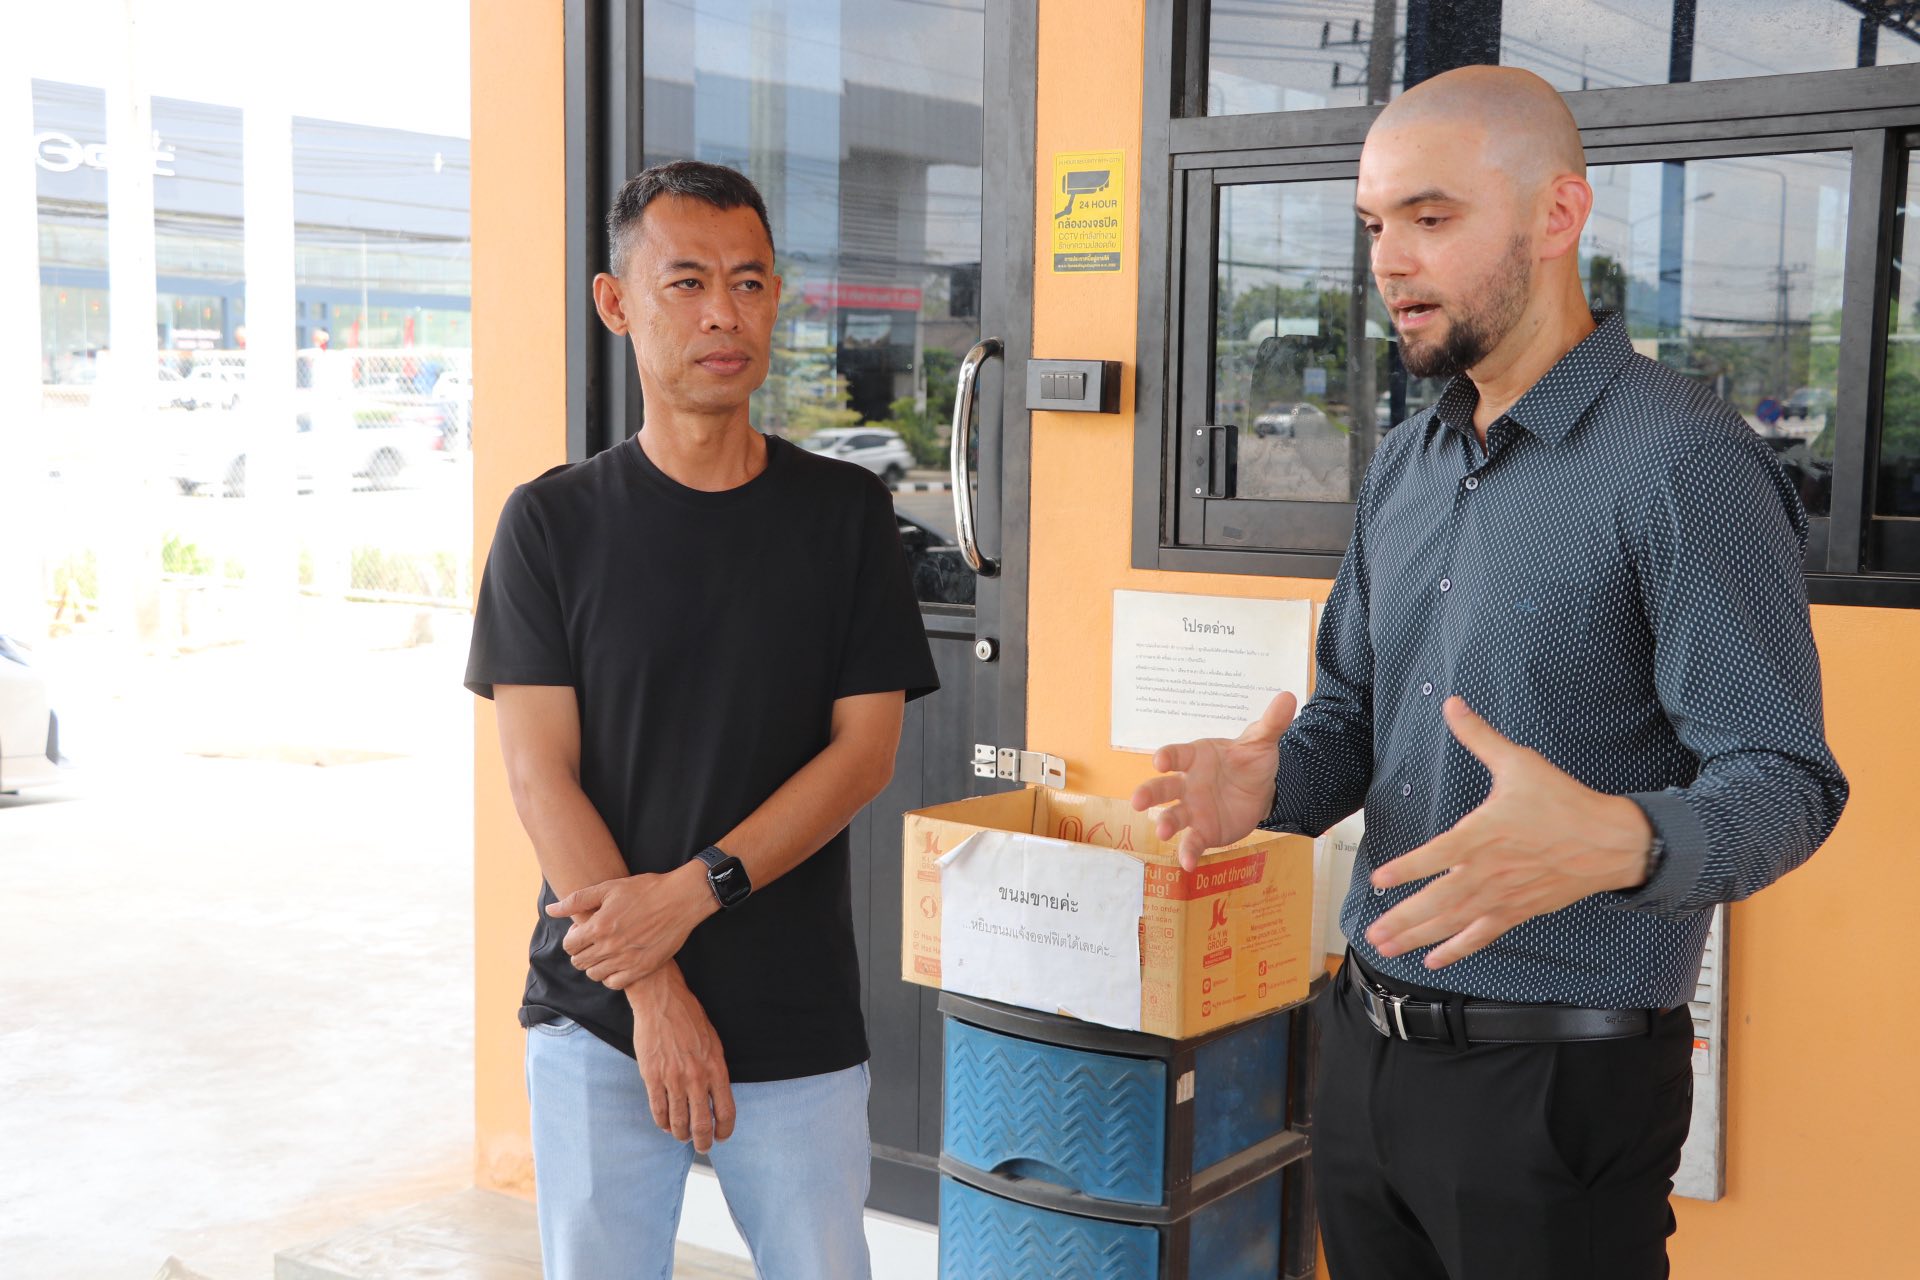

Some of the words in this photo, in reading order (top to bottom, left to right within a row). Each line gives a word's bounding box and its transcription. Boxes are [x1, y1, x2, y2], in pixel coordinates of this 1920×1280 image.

[1079, 201, 1089, 209] 24
[1092, 200, 1118, 209] HOUR
[1058, 217, 1118, 229] กล้องวงจรปิด
[1182, 617, 1235, 636] โปรดอ่าน
[1165, 869, 1181, 882] of
[1196, 873, 1209, 890] Do
[1211, 869, 1227, 885] not
[998, 886, 1079, 913] ขนมขายค่ะ
[1208, 937, 1228, 950] GROUP
